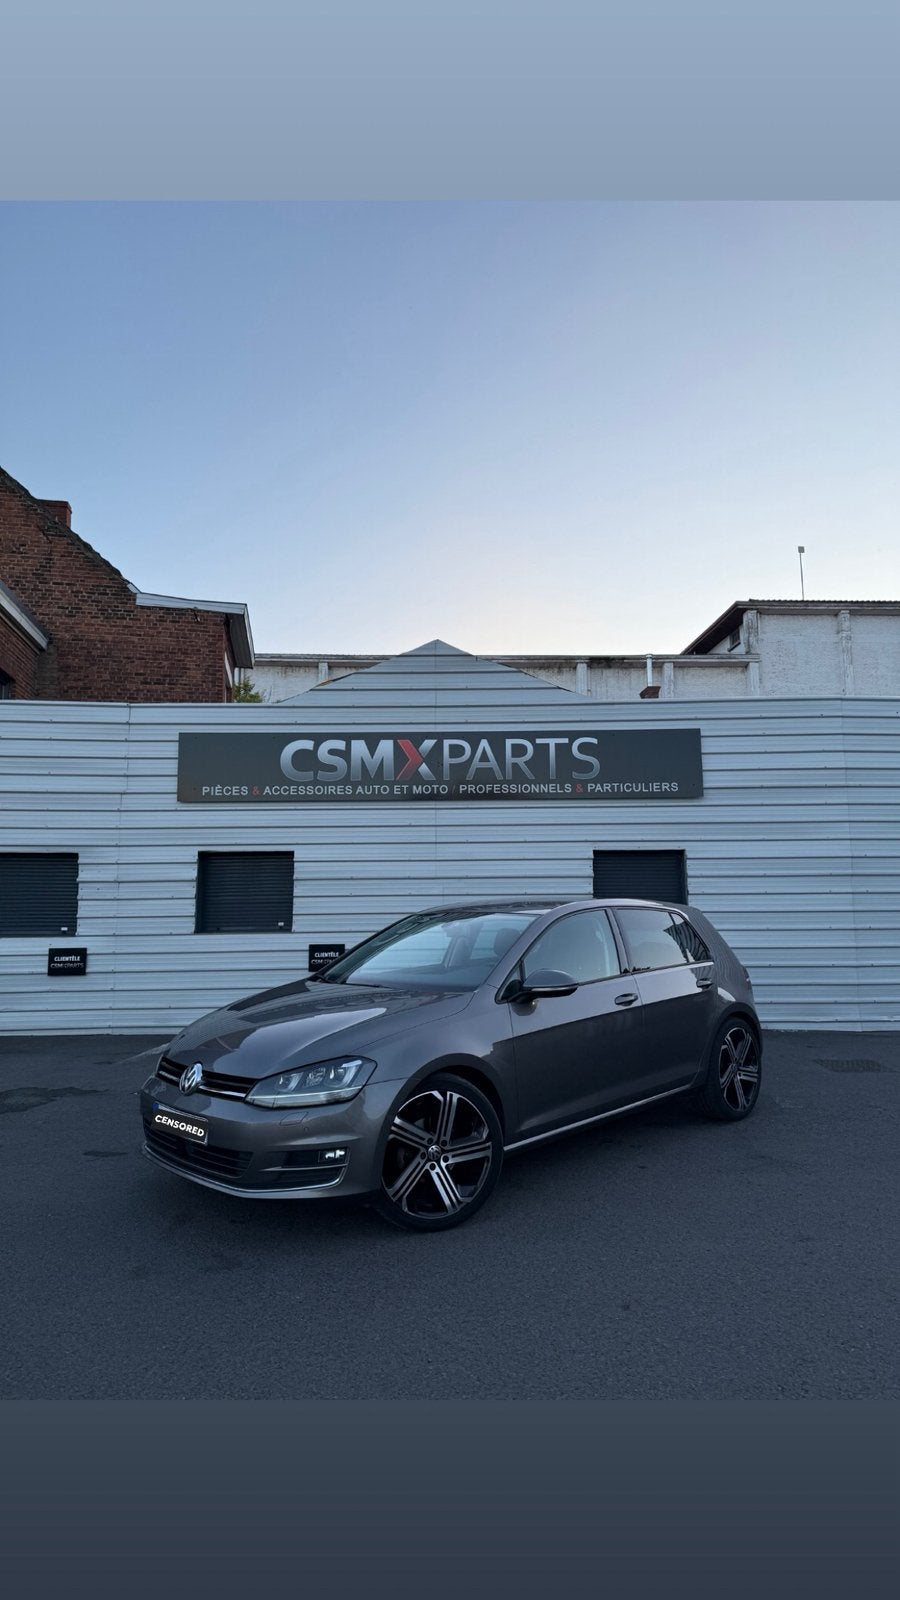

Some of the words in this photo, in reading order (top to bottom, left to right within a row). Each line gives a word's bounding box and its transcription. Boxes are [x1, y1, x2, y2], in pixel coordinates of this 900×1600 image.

[279, 738, 601, 782] CSMXPARTS
[202, 784, 248, 796] PIÈCES
[251, 786, 260, 796] &
[263, 785, 352, 796] ACCESSOIRES
[355, 785, 390, 795] AUTO
[393, 785, 408, 795] ET
[412, 784, 449, 795] MOTO
[459, 783, 572, 794] PROFESSIONNELS
[575, 783, 584, 793] &
[587, 782, 679, 793] PARTICULIERS
